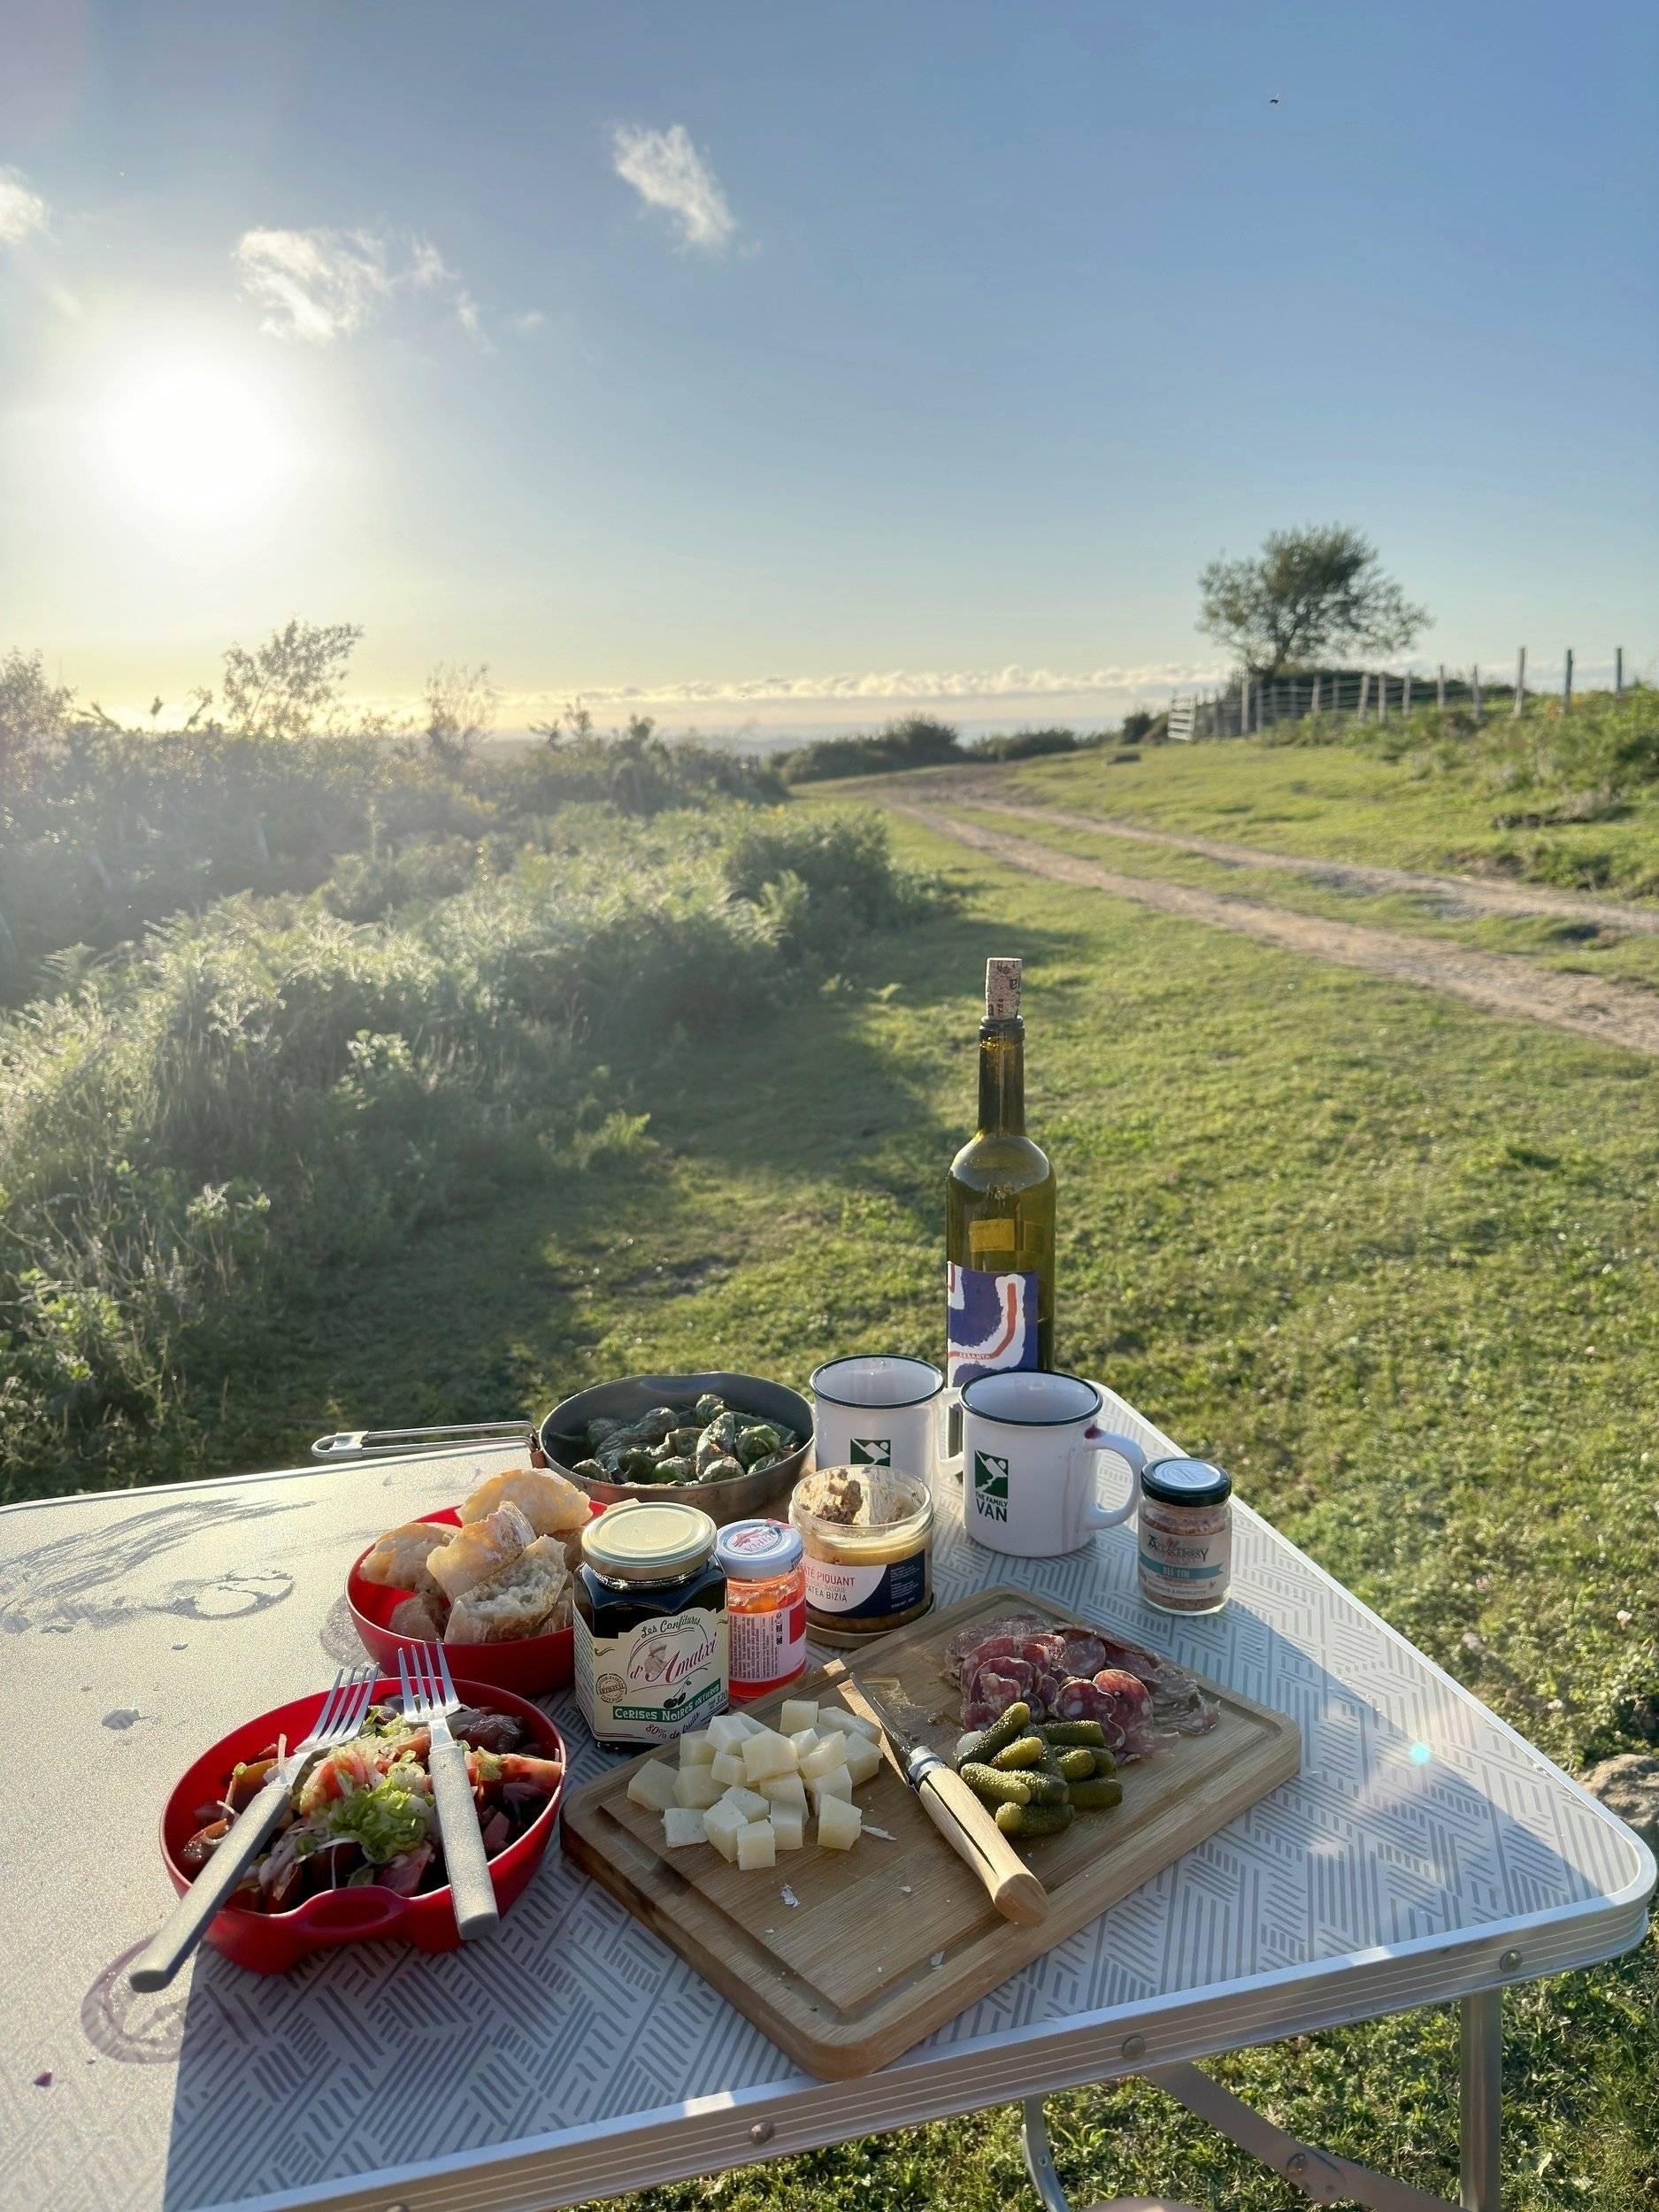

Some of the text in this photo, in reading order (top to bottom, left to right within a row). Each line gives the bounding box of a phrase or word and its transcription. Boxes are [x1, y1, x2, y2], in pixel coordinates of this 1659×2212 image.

[975, 1491, 1008, 1508] THE FAMILY
[976, 1498, 1007, 1523] VAN
[817, 1571, 856, 1586] PIQUANT
[826, 1591, 847, 1602] BIZIA
[641, 1615, 701, 1639] Les Confitures
[645, 1724, 667, 1739] 80%
[670, 1729, 680, 1740] de
